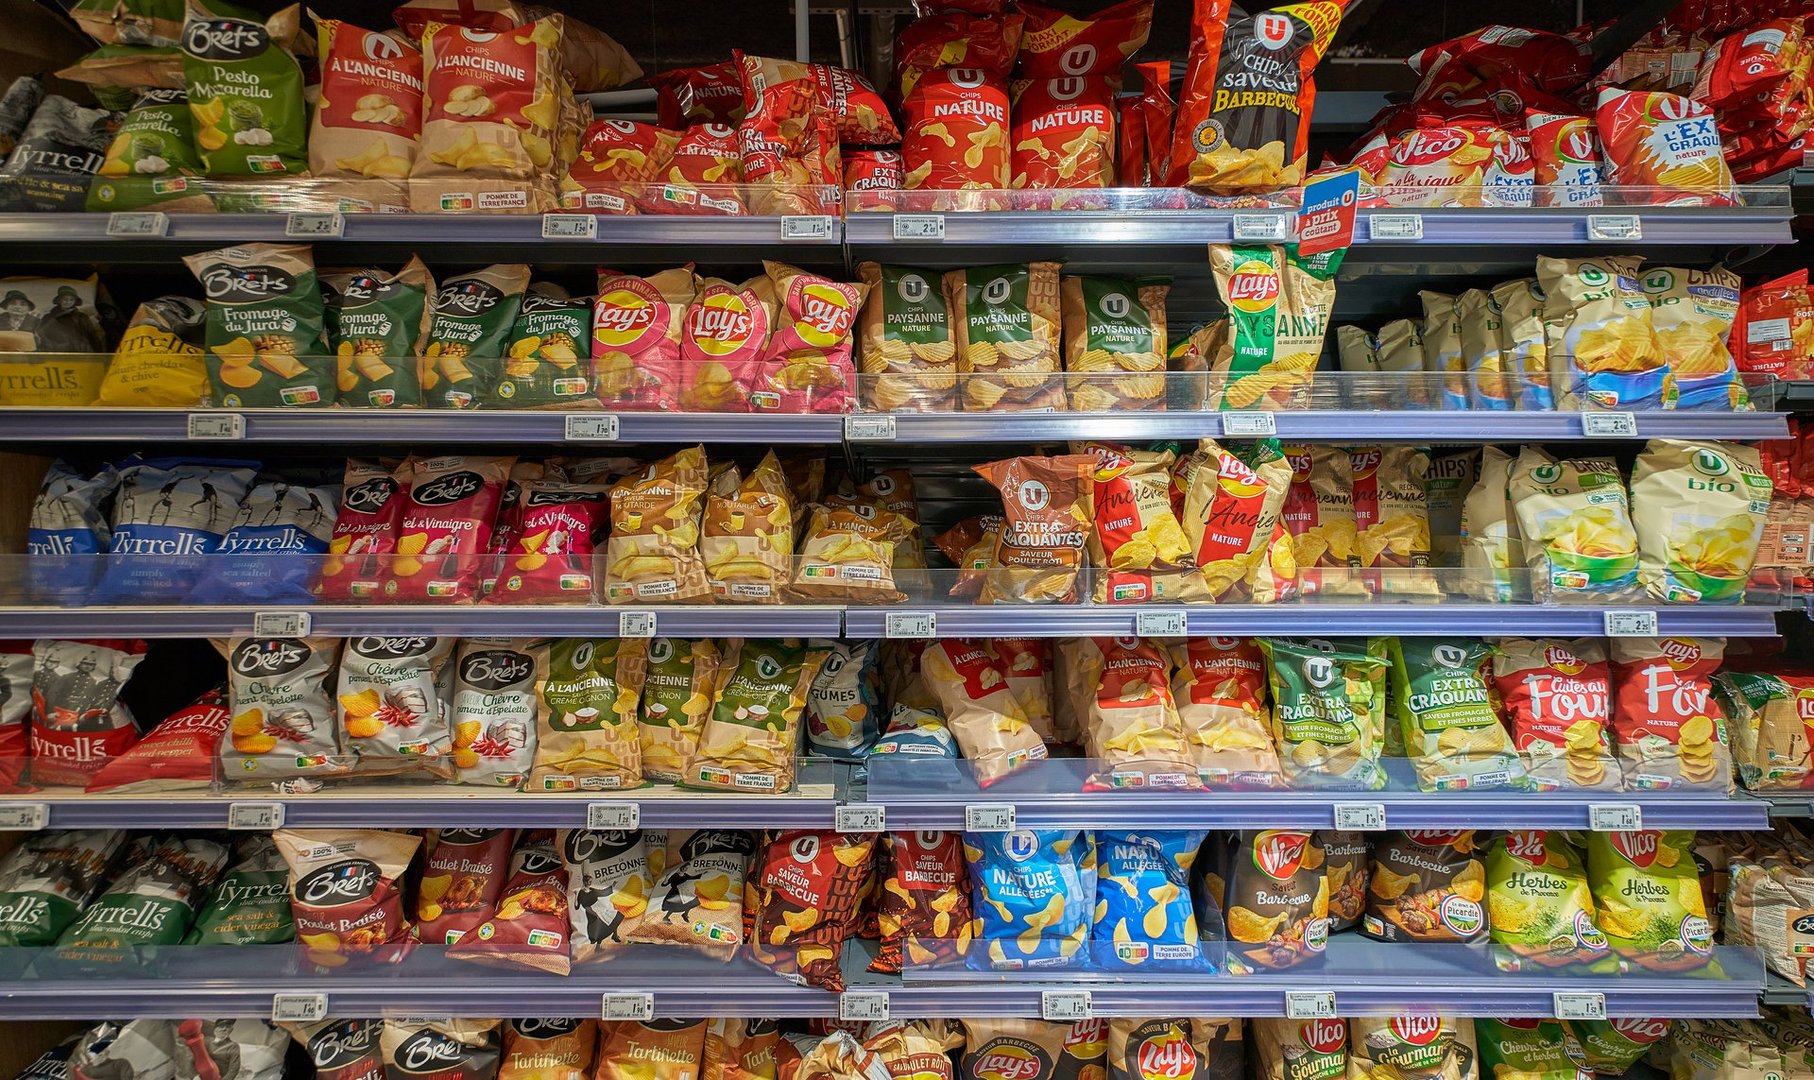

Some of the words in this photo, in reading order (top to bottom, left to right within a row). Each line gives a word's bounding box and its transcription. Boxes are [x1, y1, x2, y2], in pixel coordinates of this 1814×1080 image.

[189, 22, 260, 54] Brets
[465, 46, 490, 56] CHIPS
[332, 57, 341, 72] À
[446, 55, 525, 81] L'ANCIENNE
[214, 66, 259, 84] Pesto
[455, 69, 495, 83] NATURE
[361, 76, 402, 92] NATURE
[695, 86, 742, 99] NATURE
[1214, 90, 1300, 115] BARBECUE
[136, 110, 173, 122] Pesto
[935, 101, 1003, 122] NATURE
[1032, 110, 1103, 133] NATURE
[1396, 133, 1461, 163] Vico
[1676, 149, 1707, 161] nature
[1404, 171, 1416, 184] la
[498, 199, 525, 207] FRANCE
[1307, 196, 1340, 213] produit
[1401, 192, 1429, 203] nature
[1306, 218, 1311, 226] à
[1312, 209, 1339, 226] prix
[1305, 222, 1338, 237] coûtant
[203, 268, 288, 296] Brets
[1231, 274, 1278, 300] Lay's
[437, 287, 498, 313] Brets
[223, 308, 290, 325] Fromage
[528, 313, 578, 326] Fromage
[594, 301, 653, 332] Lay's
[802, 293, 850, 333] Lay's
[887, 313, 944, 324] PAYSANNE
[971, 313, 1027, 326] PAYSANNE
[225, 321, 243, 332] du
[243, 319, 280, 334] Jura
[349, 322, 377, 336] Jura
[435, 317, 482, 333] Fromage
[526, 324, 539, 333] du
[539, 322, 568, 334] Jura
[694, 306, 750, 341] Lay's
[986, 324, 1014, 332] NATURE
[1091, 325, 1148, 336] PAYSANNE
[442, 329, 468, 340] Jura
[1241, 346, 1268, 356] NATURE
[131, 371, 160, 383] chive
[420, 478, 476, 503] Brets
[1105, 517, 1133, 531] NATURE
[1284, 513, 1312, 521] NATURE
[426, 518, 473, 532] Vinaigre
[1016, 520, 1060, 533] EXTRA
[216, 529, 306, 555] Tyrrells
[1003, 527, 1084, 548] CRAQUANTES
[1211, 533, 1243, 547] NATURE
[113, 532, 207, 564] Tyrrells
[1020, 550, 1053, 558] SAVEUR
[1008, 557, 1042, 565] POULET
[238, 646, 302, 670] Brets
[1661, 640, 1698, 662] Lay's
[367, 662, 407, 676] Chèvre
[462, 657, 528, 683] Brets
[1119, 667, 1148, 675] NATURE
[1195, 658, 1202, 668] À
[1204, 658, 1261, 671] L'ANCIENNE
[1216, 668, 1244, 676] NATURE
[348, 675, 372, 686] piment
[373, 671, 420, 686] d'Espelette
[1445, 670, 1467, 678] CHIPS
[547, 681, 555, 692] À
[557, 677, 615, 693] L'ANCIENNE
[1550, 678, 1581, 694] Cuites
[1584, 681, 1605, 694] au
[483, 693, 522, 707] Chèvre
[1298, 693, 1345, 709] EXTRA
[457, 705, 485, 715] piment
[486, 705, 528, 717] d'Espelette
[1423, 712, 1447, 721] SAVEUR
[1449, 709, 1481, 718] FROMAGE
[1467, 715, 1493, 723] HERBES
[1647, 719, 1679, 727] NATURE
[1310, 725, 1342, 734] FROMAGE
[1325, 733, 1351, 741] HERBES
[170, 737, 193, 746] chilli
[1621, 831, 1656, 855] Vico
[1262, 838, 1303, 874] Vico
[1390, 849, 1451, 875] Barbecue
[460, 860, 493, 875] Braisé
[594, 857, 646, 878] BRETONNE
[693, 859, 743, 870] BRETONNE
[788, 864, 804, 875] CHIPS
[916, 860, 944, 871] SAVEUR
[777, 867, 810, 888] SAVEUR
[905, 870, 956, 884] BARBECUE
[992, 868, 1057, 887] NATURE
[1506, 872, 1567, 891] Herbes
[305, 872, 375, 901] Brets
[767, 874, 819, 905] BARBECUE
[1272, 882, 1297, 892] Saveur
[1531, 889, 1559, 897] Provence
[1622, 879, 1670, 896] Herbes
[1256, 891, 1311, 906] Barbecue
[75, 900, 172, 935] Tyrrells
[227, 913, 247, 921] sea
[248, 911, 265, 920] salt
[266, 912, 274, 920] &
[1447, 907, 1479, 918] Picardie
[214, 922, 242, 933] cider
[244, 921, 280, 931] vinegar
[299, 918, 337, 931] Poulet
[340, 910, 386, 932] Braisé
[1306, 1020, 1343, 1046] Vico
[1396, 1014, 1437, 1039] Vico
[627, 1041, 695, 1063] Tartiflette
[1500, 1041, 1541, 1055] Chèvre
[511, 1050, 580, 1070] Tartiflette
[1144, 1040, 1195, 1075] Lay's
[1299, 1057, 1308, 1066] La
[1532, 1051, 1560, 1062] herbes
[981, 1055, 1040, 1078] Lay's
